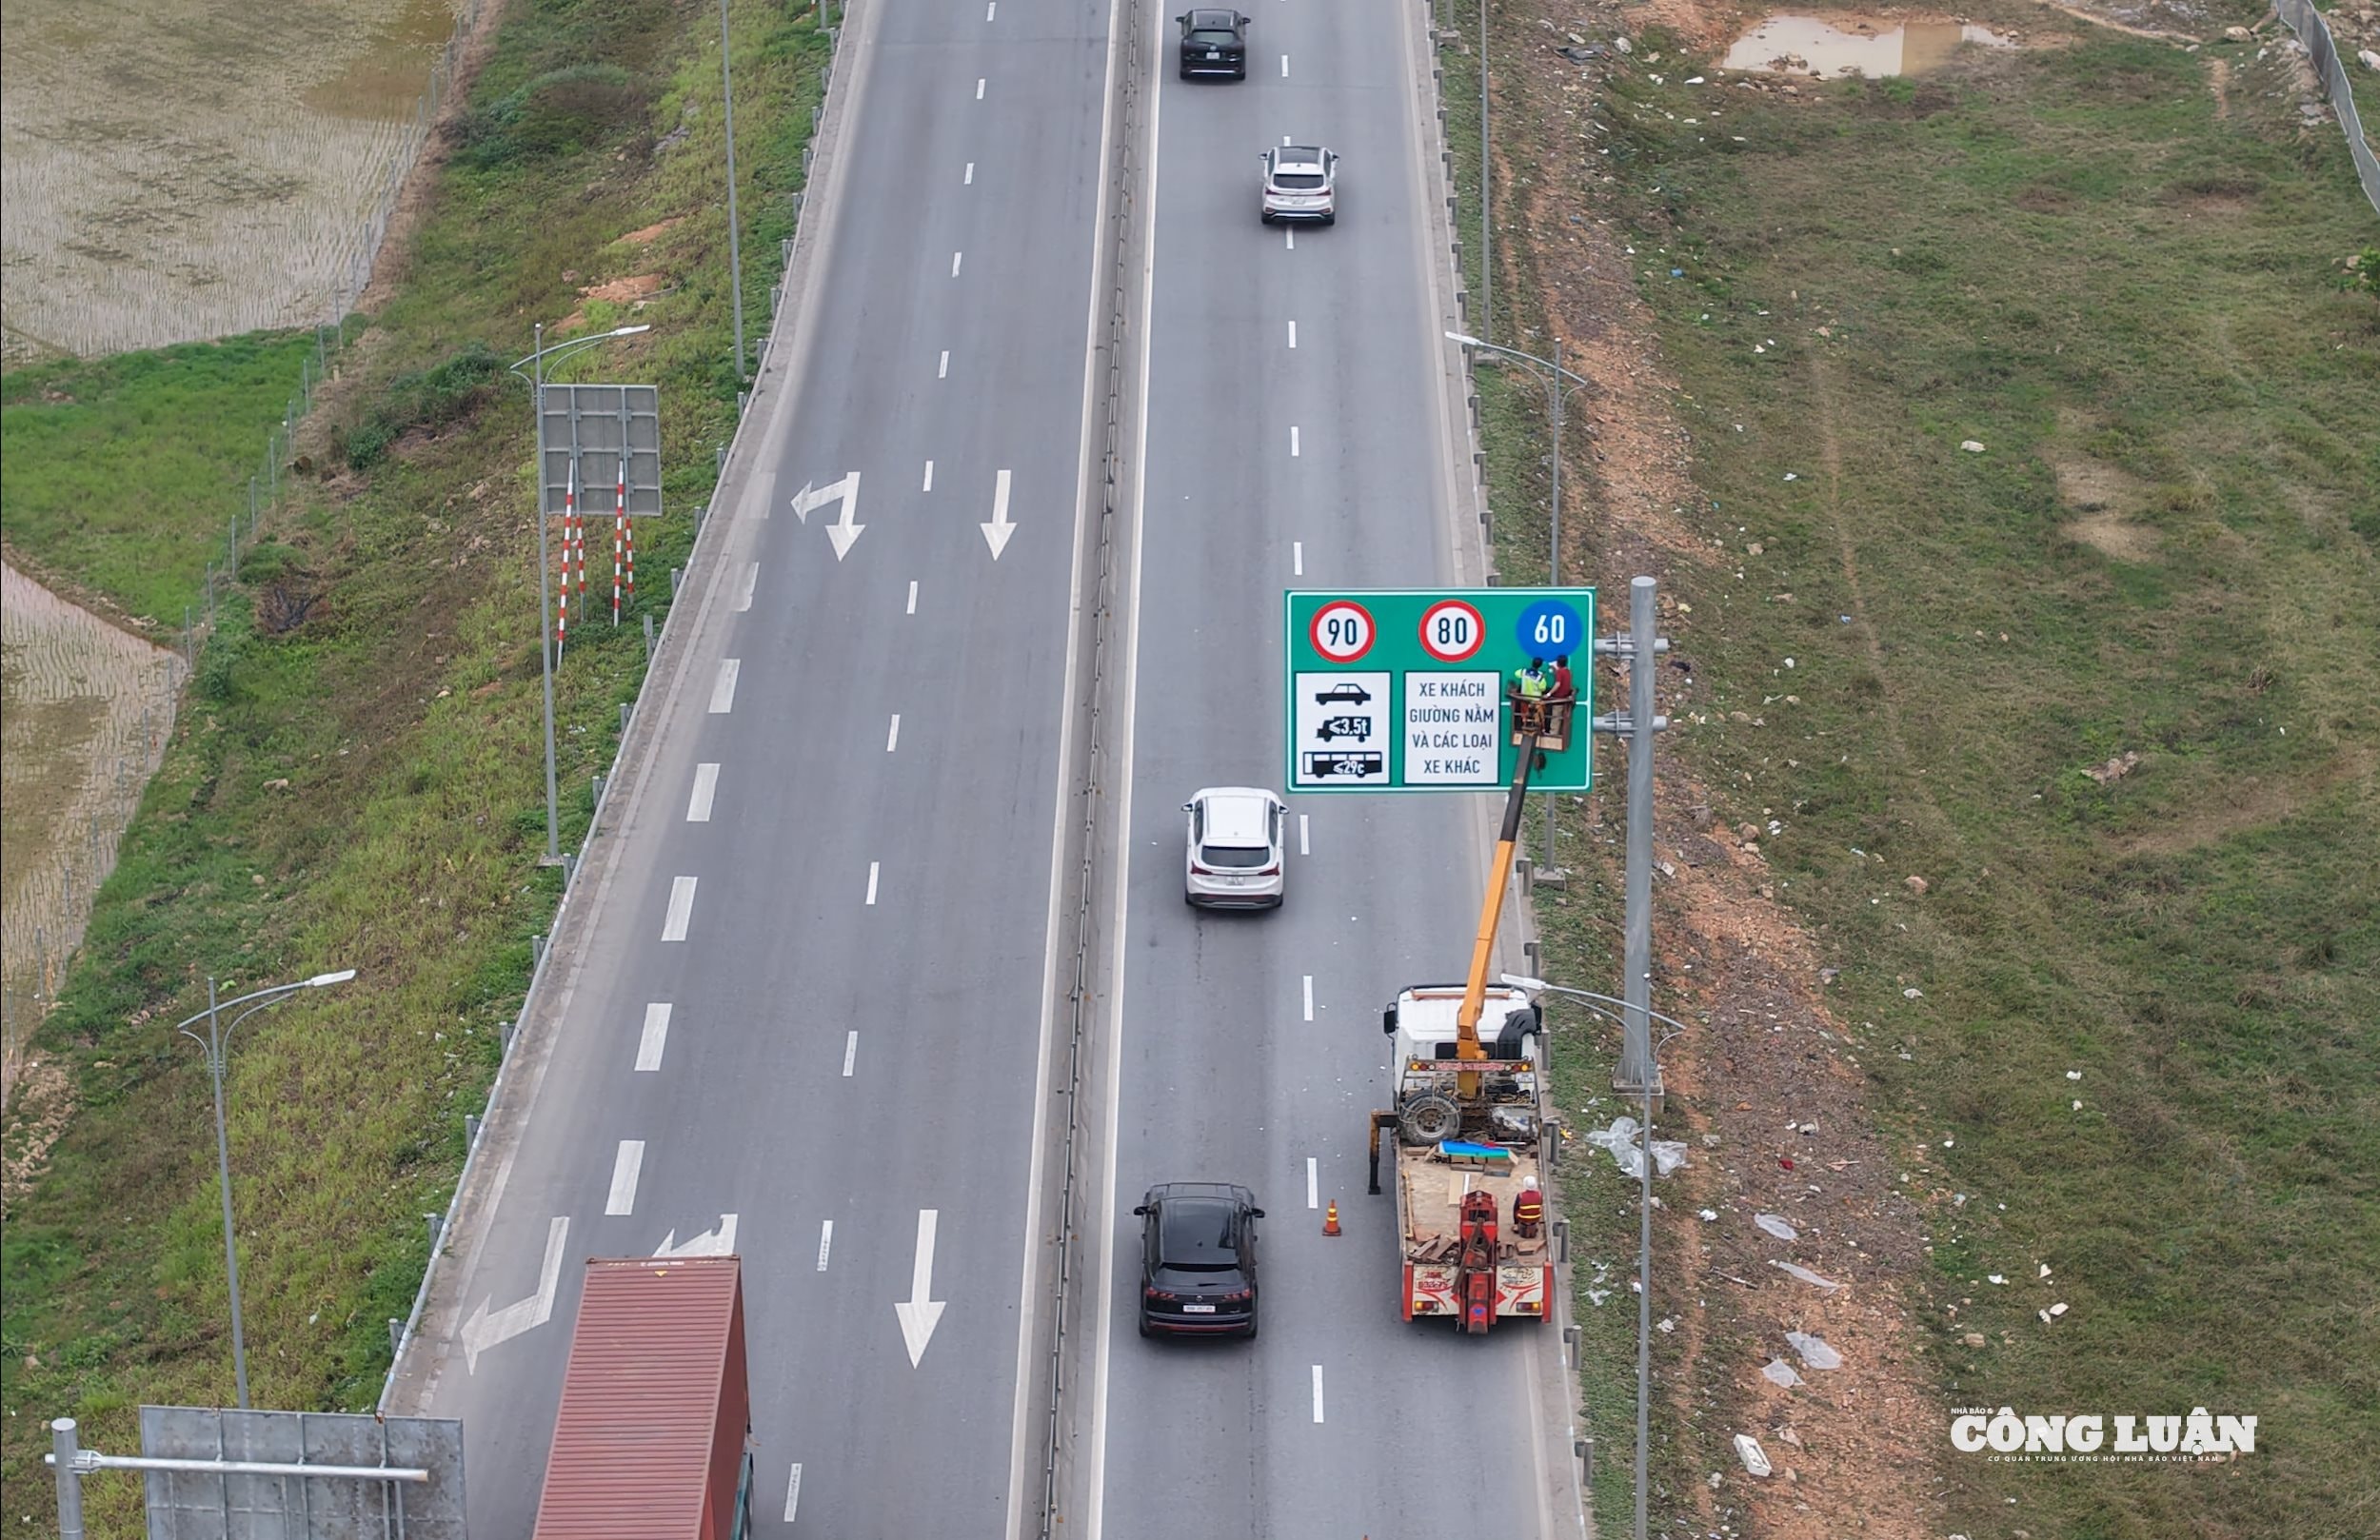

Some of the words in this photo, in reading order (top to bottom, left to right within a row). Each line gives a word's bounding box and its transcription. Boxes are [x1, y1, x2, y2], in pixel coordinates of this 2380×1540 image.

[1327, 619, 1358, 646] 90
[1438, 617, 1468, 644] 80
[1534, 614, 1565, 644] 60
[1419, 682, 1437, 697] XE
[1440, 679, 1485, 697] KHÁCH
[1409, 704, 1460, 723] GIƯỜNG
[1464, 702, 1494, 723] NẰM
[1412, 730, 1430, 748] VÀ
[1433, 730, 1458, 748] CÁC
[1462, 734, 1492, 751] LOẠI
[1424, 760, 1440, 774] XE
[1444, 756, 1480, 774] KHÁC
